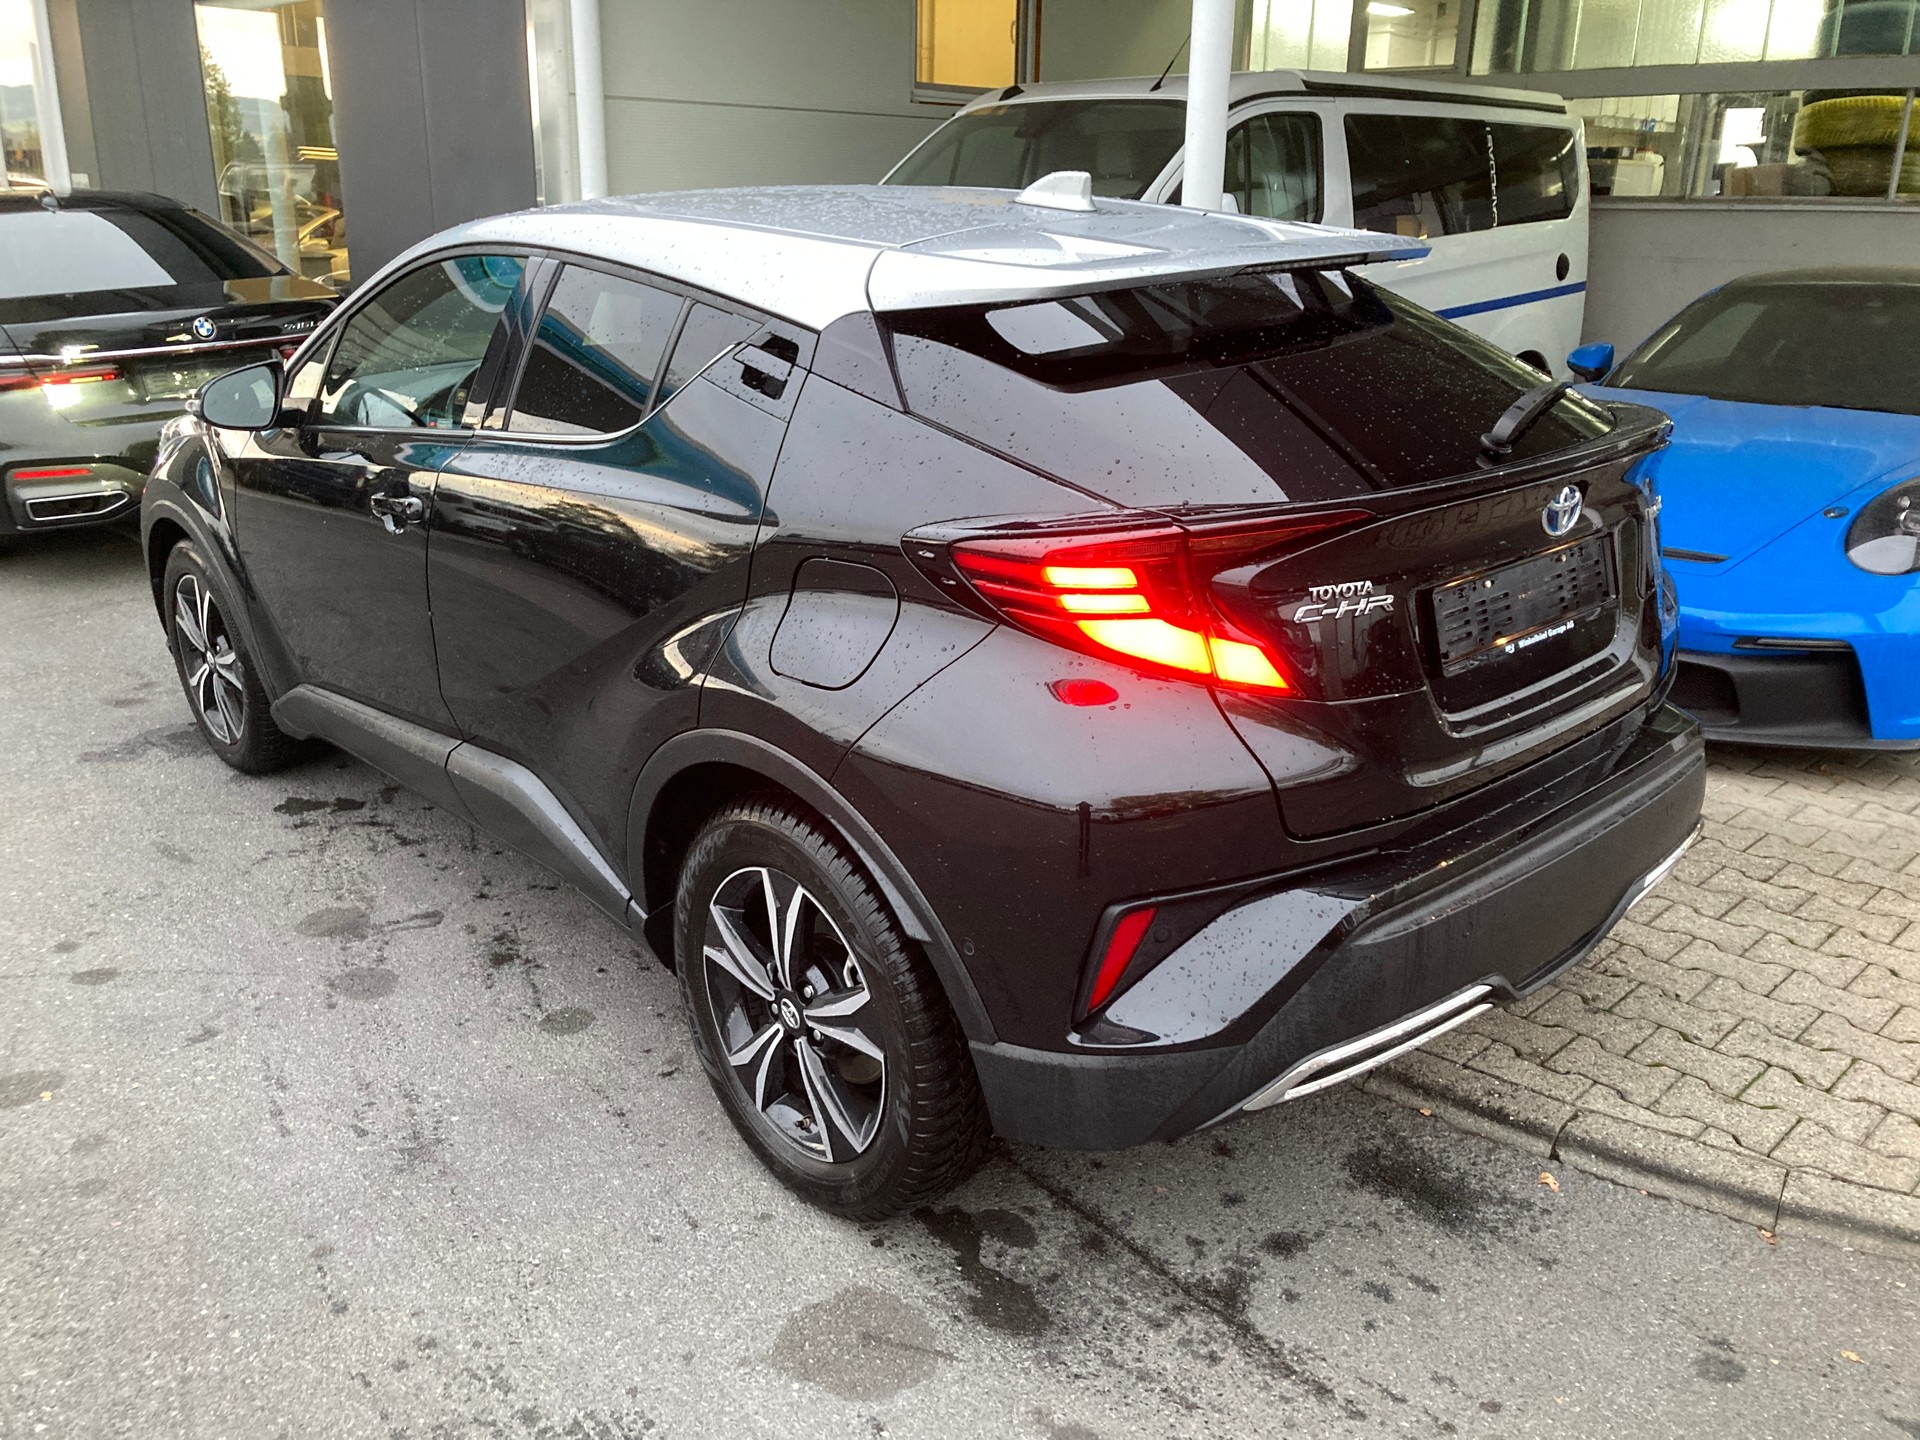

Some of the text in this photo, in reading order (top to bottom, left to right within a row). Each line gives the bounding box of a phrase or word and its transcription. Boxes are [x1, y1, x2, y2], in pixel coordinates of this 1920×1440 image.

[1309, 580, 1374, 602] TOYOTA
[1294, 594, 1394, 623] C-HR
[1548, 625, 1566, 637] Garage
[1567, 620, 1574, 630] AG
